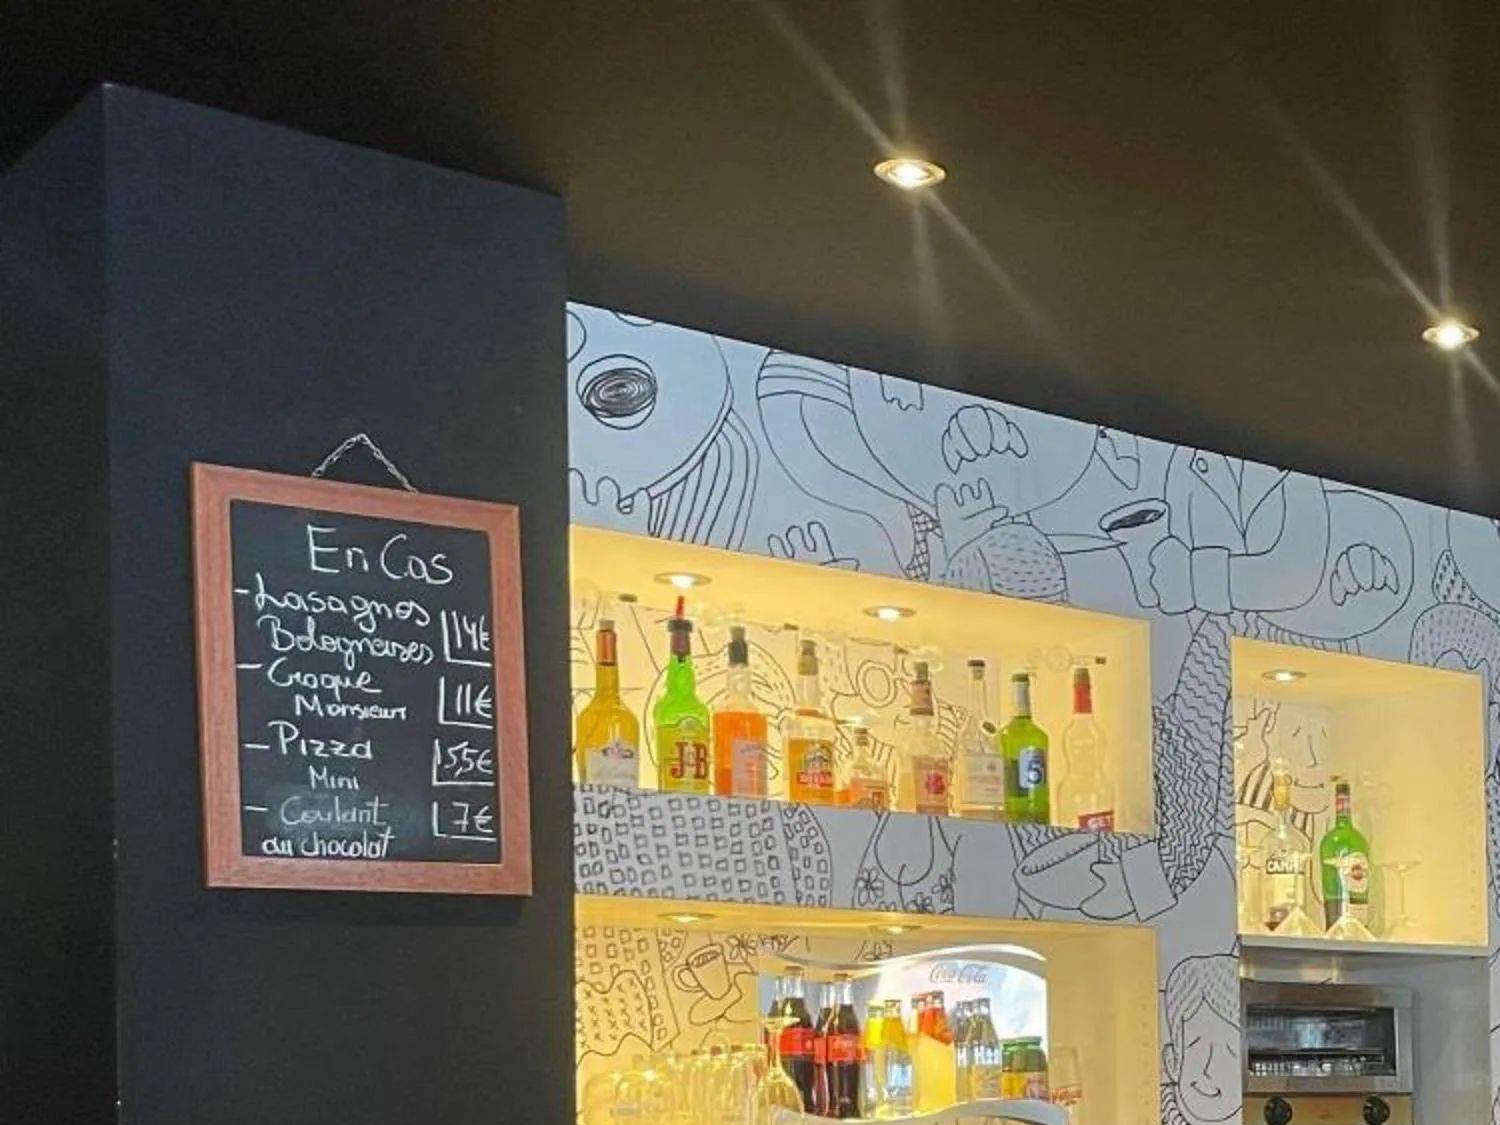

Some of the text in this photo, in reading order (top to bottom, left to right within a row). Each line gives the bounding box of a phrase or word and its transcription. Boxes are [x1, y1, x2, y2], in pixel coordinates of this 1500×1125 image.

[307, 524, 454, 586] En Cas
[267, 655, 383, 701] Croque
[294, 694, 409, 721] Monsieur
[267, 721, 374, 761] Pizza
[308, 764, 360, 792] Mini
[279, 795, 390, 829] Coulant
[451, 801, 494, 834] 7€
[260, 824, 396, 860] au chocolat
